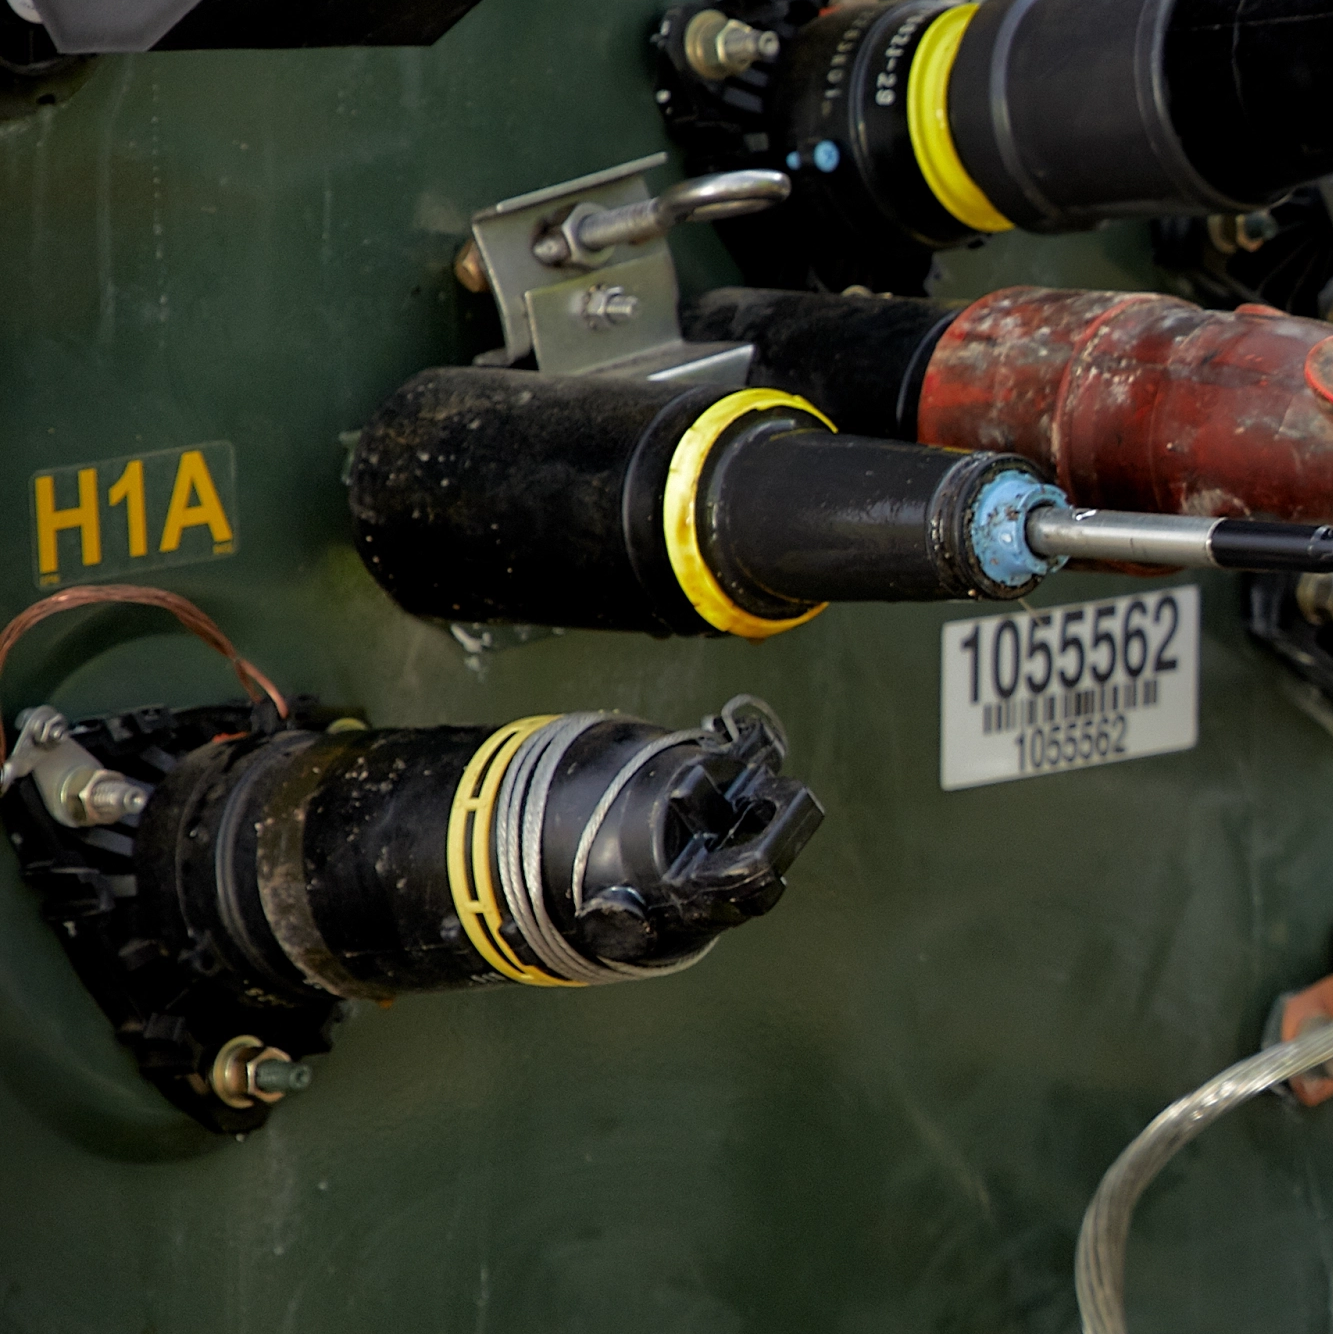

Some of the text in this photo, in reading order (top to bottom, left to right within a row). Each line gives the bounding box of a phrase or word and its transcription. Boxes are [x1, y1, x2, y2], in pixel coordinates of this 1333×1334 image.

[35, 450, 233, 574] H1A
[961, 595, 1179, 704] 1055562
[1015, 716, 1128, 771] 1055562
